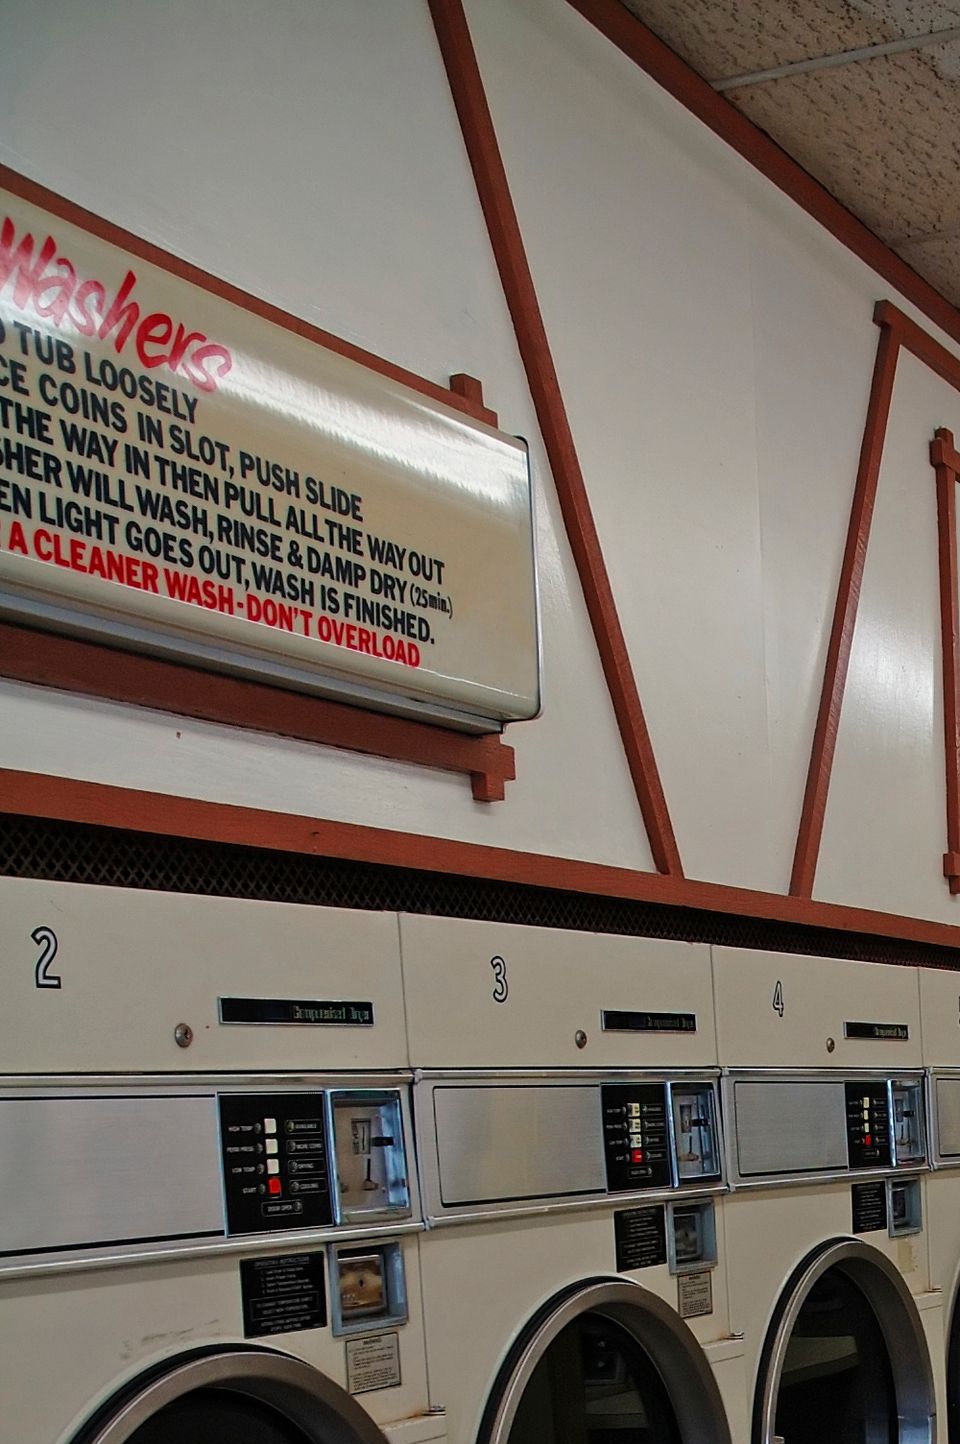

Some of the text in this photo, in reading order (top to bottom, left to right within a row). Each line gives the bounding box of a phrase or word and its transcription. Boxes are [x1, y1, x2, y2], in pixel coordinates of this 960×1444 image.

[0, 217, 232, 393] Washers
[13, 320, 77, 374] TUB
[84, 352, 198, 424] LOOSELY
[0, 396, 446, 585] THE WAY IN THEN PULL ALL THE WAY OUT
[0, 437, 62, 489] HER
[66, 460, 134, 512] WILL
[135, 485, 215, 544] WASH,
[217, 513, 284, 563] RINSE
[287, 540, 304, 570] &
[306, 545, 367, 589] DAMP
[370, 568, 408, 604] DRY
[39, 373, 128, 433] COINS
[137, 411, 164, 449] IN
[169, 424, 235, 478] SLOT,
[239, 450, 301, 499] PUSH
[306, 477, 364, 522] SLIDE
[8, 520, 28, 554] A
[33, 528, 159, 594] CLEANER
[317, 615, 421, 668] OVERLOAD
[39, 491, 119, 545] LIGHT
[125, 520, 194, 568] GOES
[198, 545, 250, 592] OUT,
[251, 561, 315, 607] WASH
[320, 584, 340, 614] IS
[344, 591, 436, 645] FINISHED.
[31, 926, 62, 989] 2
[490, 955, 508, 1003] 3
[772, 981, 784, 1018] 4
